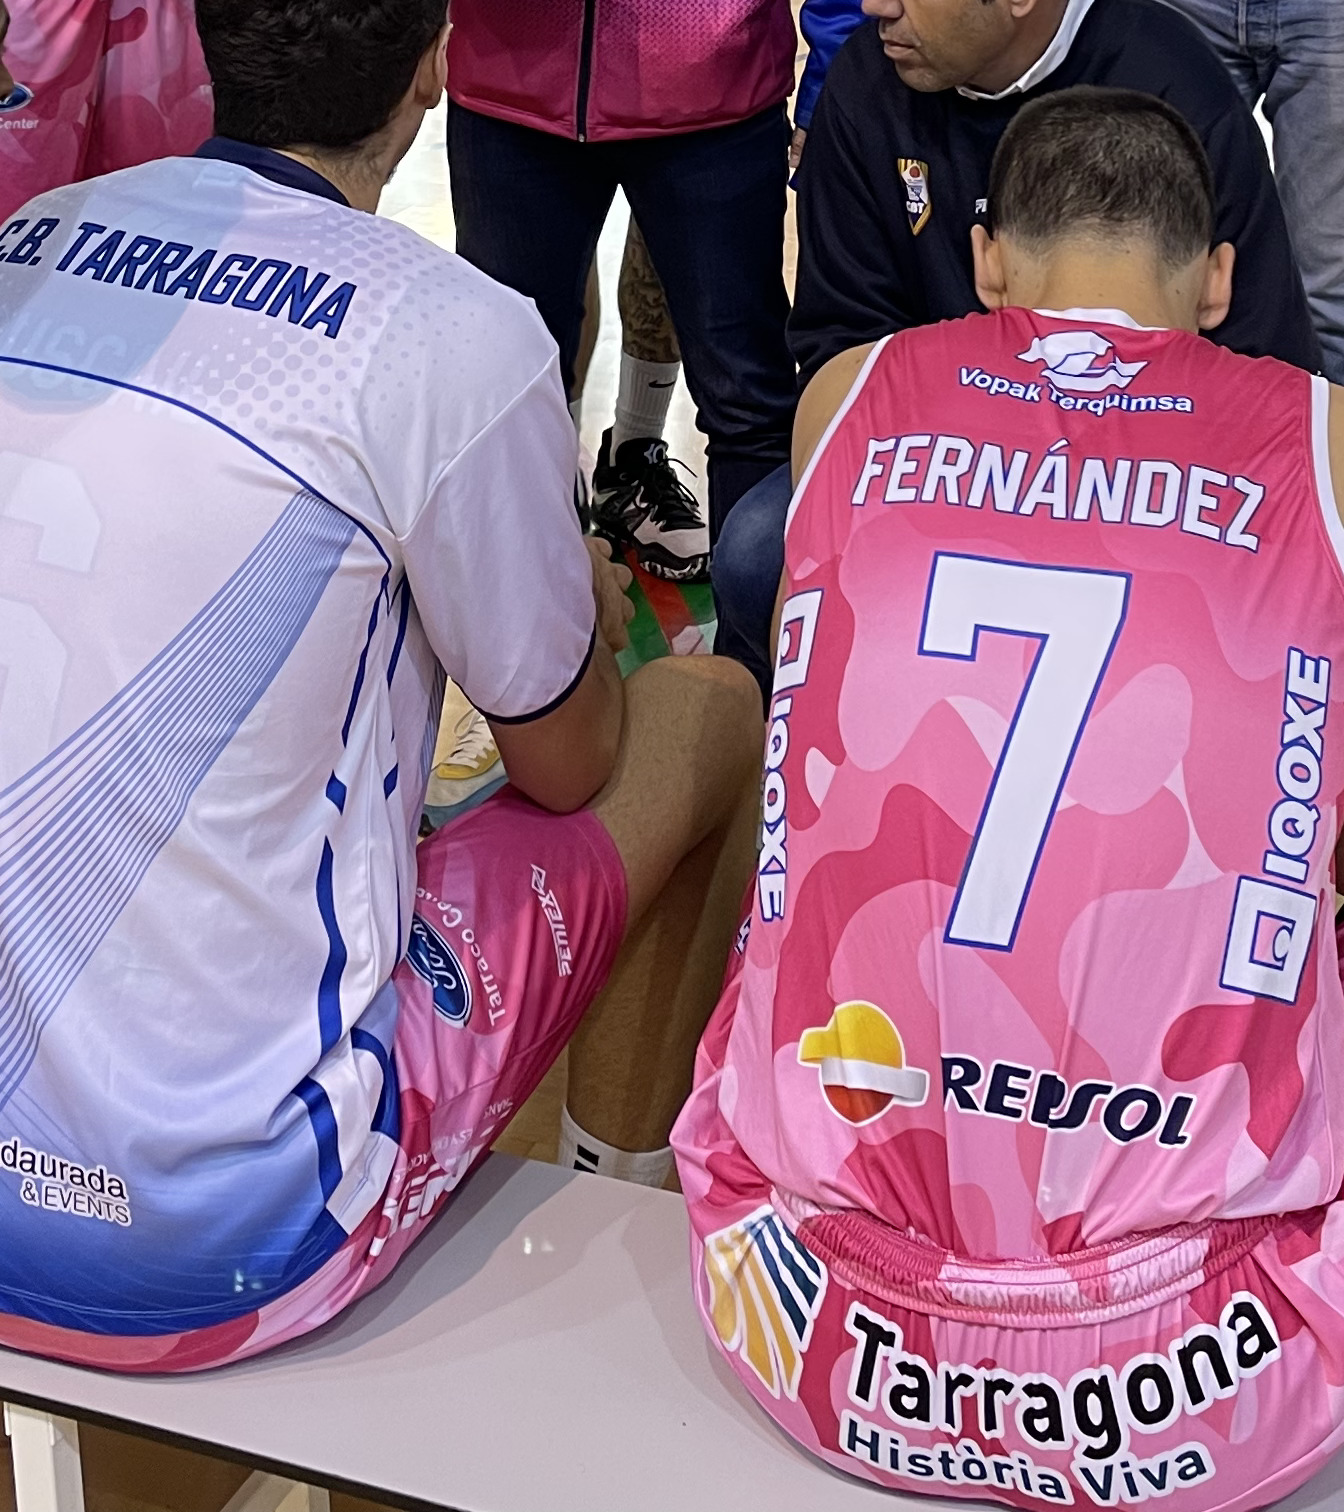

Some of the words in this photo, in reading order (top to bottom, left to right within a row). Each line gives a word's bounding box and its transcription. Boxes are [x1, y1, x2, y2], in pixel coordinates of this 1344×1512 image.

[56, 221, 358, 340] TARRAGONA
[959, 367, 1042, 402] Vopak
[851, 433, 1267, 554] FERNÁNDEZ
[757, 693, 794, 923] IQOXE
[917, 550, 1134, 953] 7
[1262, 645, 1332, 884] IQOXE
[461, 928, 506, 1027] Tarraco
[22, 1182, 39, 1204] &
[44, 1186, 132, 1226] EVENTS
[850, 1295, 1279, 1459] Tarragona
[846, 1417, 1070, 1502] Història
[1079, 1449, 1210, 1505] Viva
